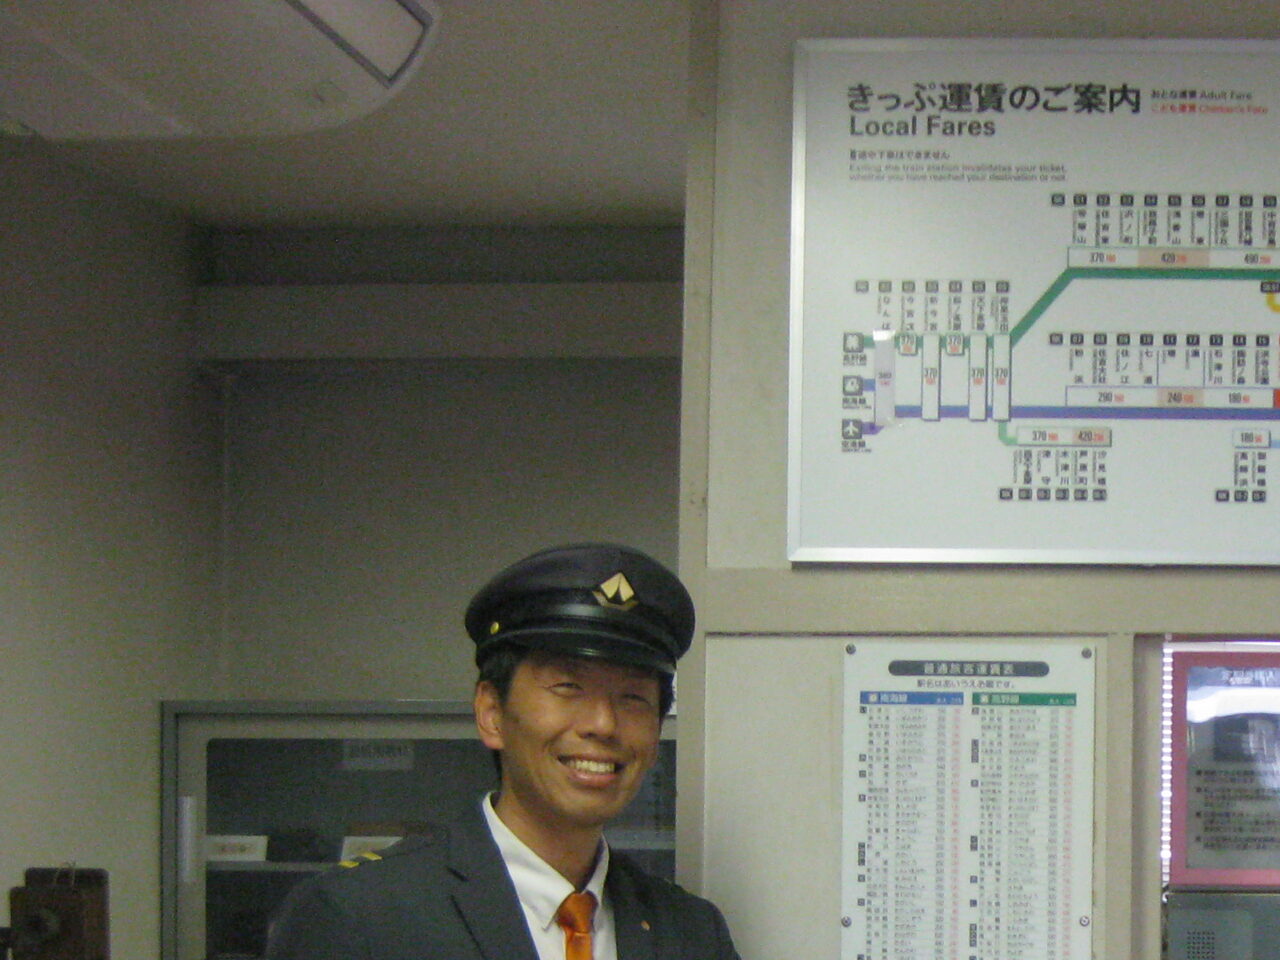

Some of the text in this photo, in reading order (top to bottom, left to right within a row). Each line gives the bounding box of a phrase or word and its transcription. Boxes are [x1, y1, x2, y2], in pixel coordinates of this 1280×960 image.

[847, 82, 1140, 113] きっぷ運賃のご案内
[1151, 90, 1252, 99] おとな運賃 Adult Fare
[850, 115, 997, 136] Local Fares
[948, 334, 961, 345] 370
[924, 367, 938, 378] 370
[971, 368, 984, 378] 370
[995, 368, 1008, 378] 370
[1032, 430, 1047, 441] 370
[1078, 430, 1093, 442] 420
[1240, 432, 1254, 443] 180
[924, 663, 1014, 675] 普通旅客運賃表
[917, 679, 1016, 689] 駅名はあいうえお順です。
